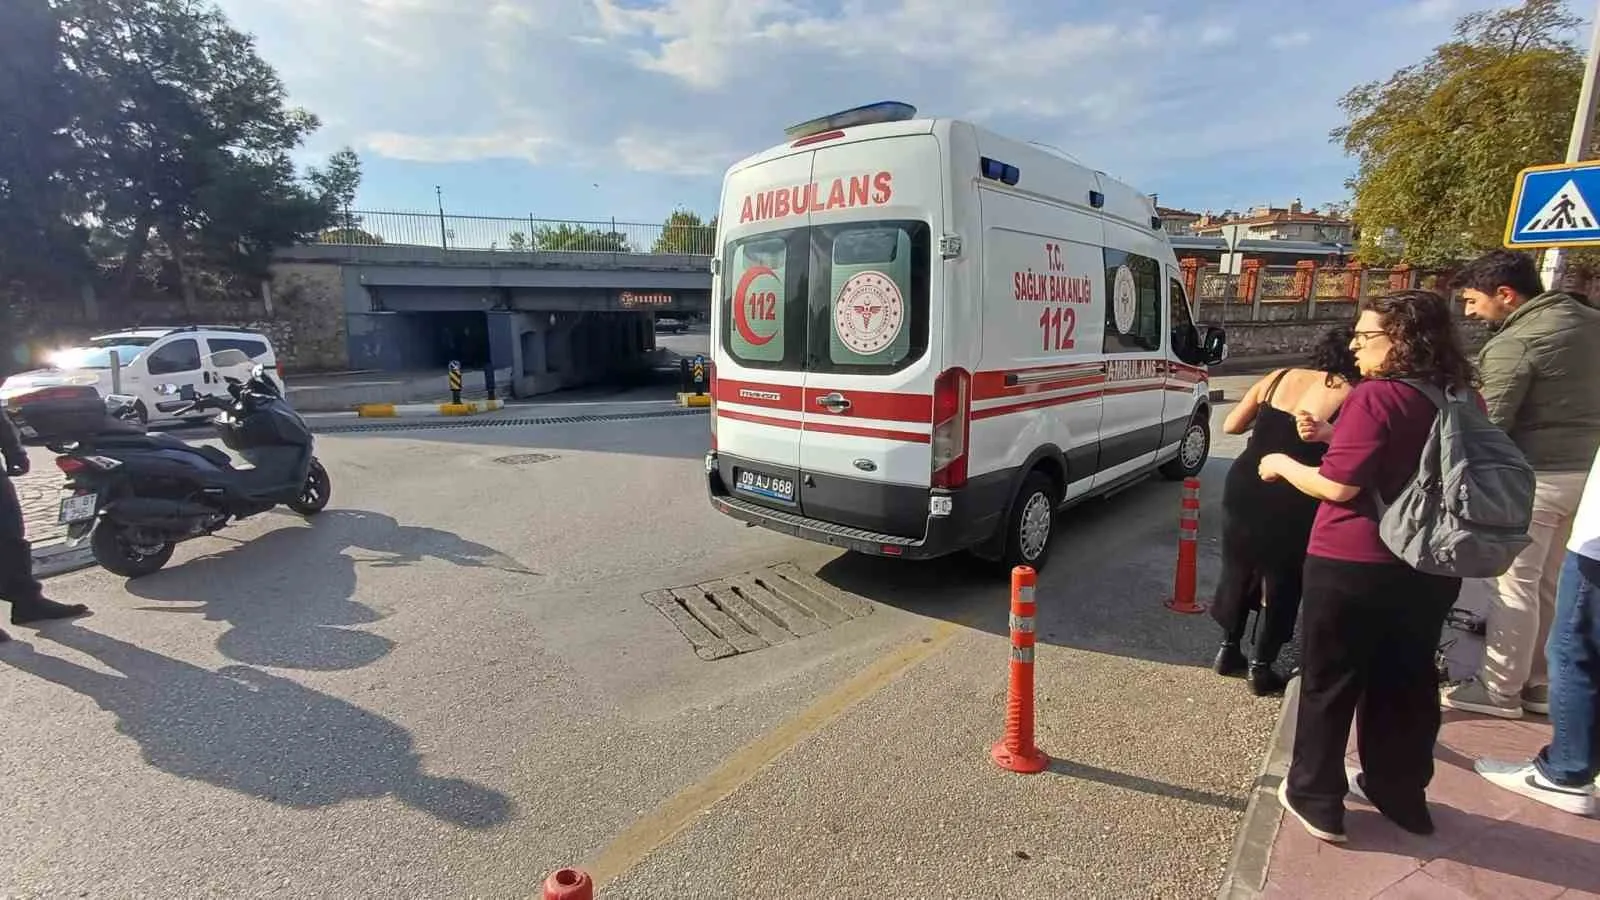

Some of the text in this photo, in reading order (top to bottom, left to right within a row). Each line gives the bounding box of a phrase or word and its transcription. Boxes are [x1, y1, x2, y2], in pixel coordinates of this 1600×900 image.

[740, 171, 892, 223] AMBULANS
[1046, 243, 1065, 272] T.C.
[1015, 267, 1092, 304] SAĞLIK BAKANLIĞI
[749, 291, 776, 320] 112
[1040, 306, 1076, 351] 112
[1107, 360, 1157, 381] AMBULANS
[742, 471, 753, 484] 09
[756, 475, 769, 488] AJ
[772, 478, 791, 494] 668
